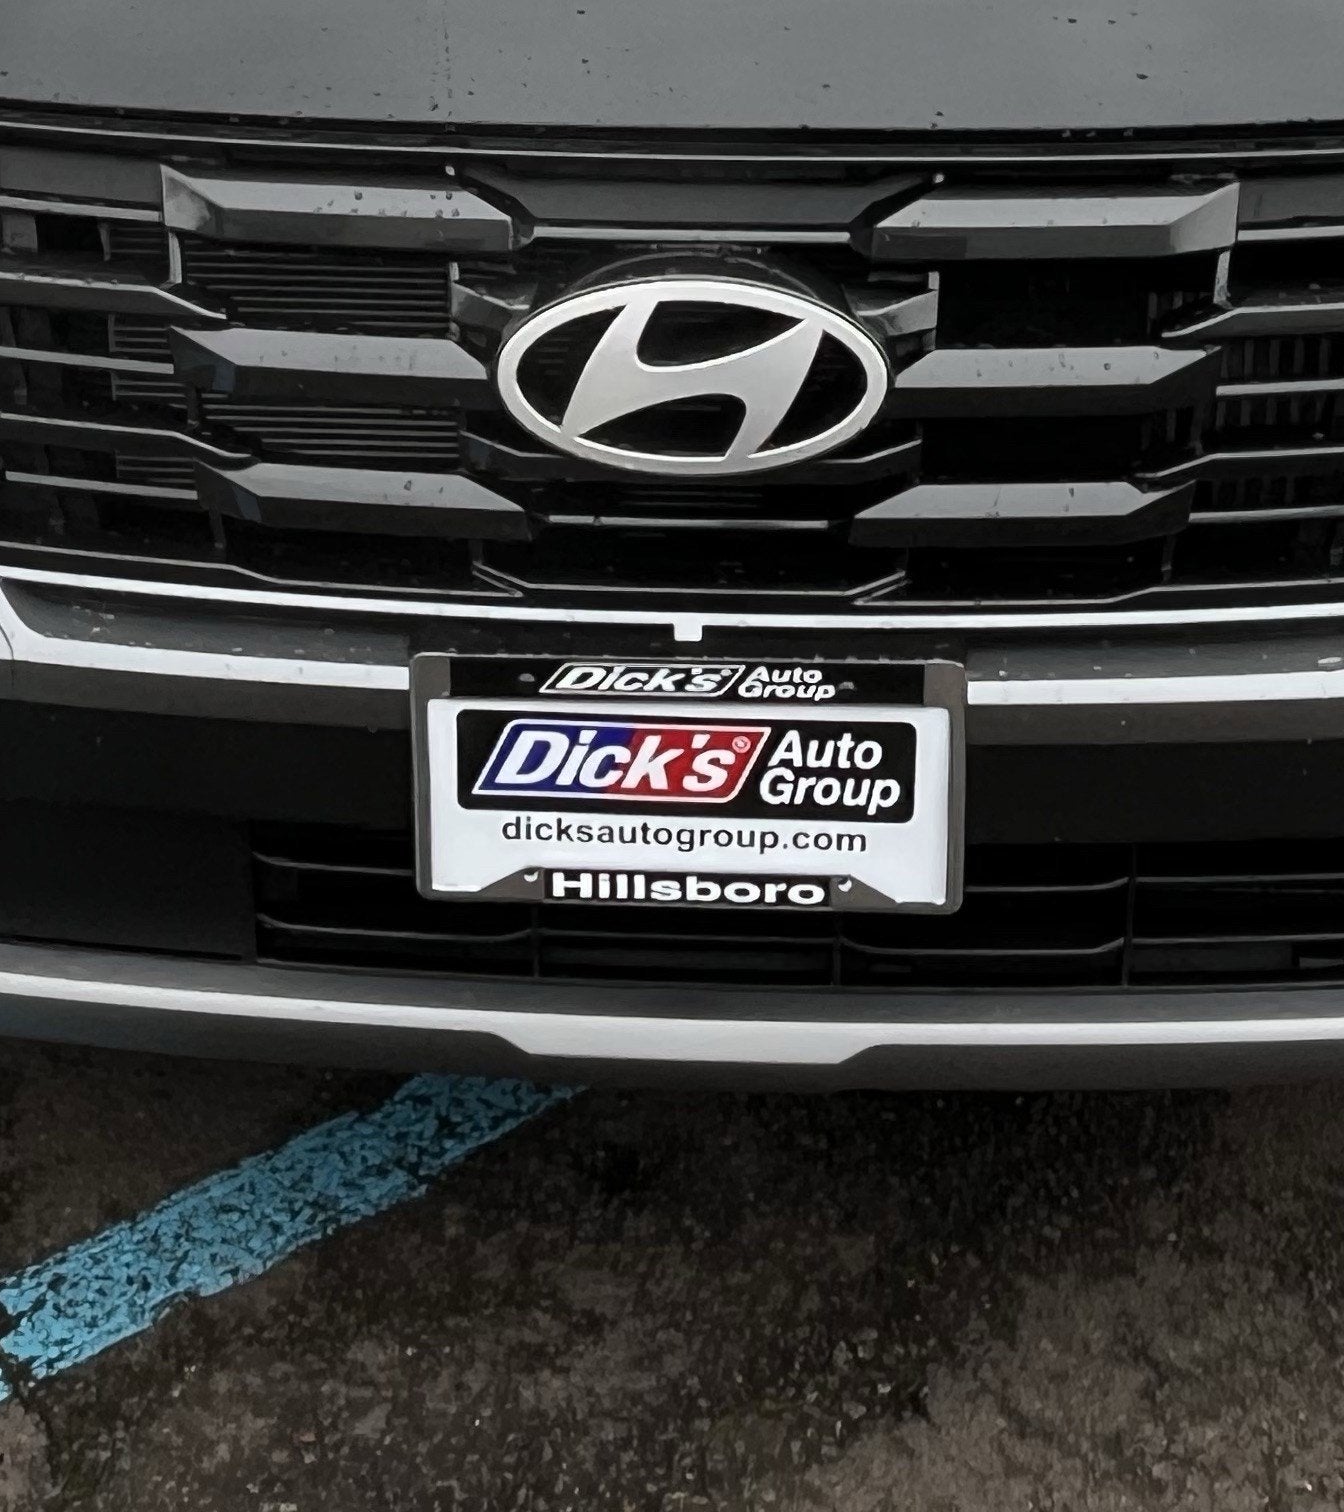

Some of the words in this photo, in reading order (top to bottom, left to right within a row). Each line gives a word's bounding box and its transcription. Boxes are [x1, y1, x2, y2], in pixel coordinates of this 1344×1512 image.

[555, 665, 722, 692] Dick's
[738, 680, 836, 701] Group
[748, 665, 823, 683] Auto
[494, 729, 740, 793] Dick's
[766, 730, 883, 770] Auto
[759, 768, 901, 816] Group
[502, 816, 867, 853] dicksautogroup.com
[551, 871, 826, 905] Hillsboro
